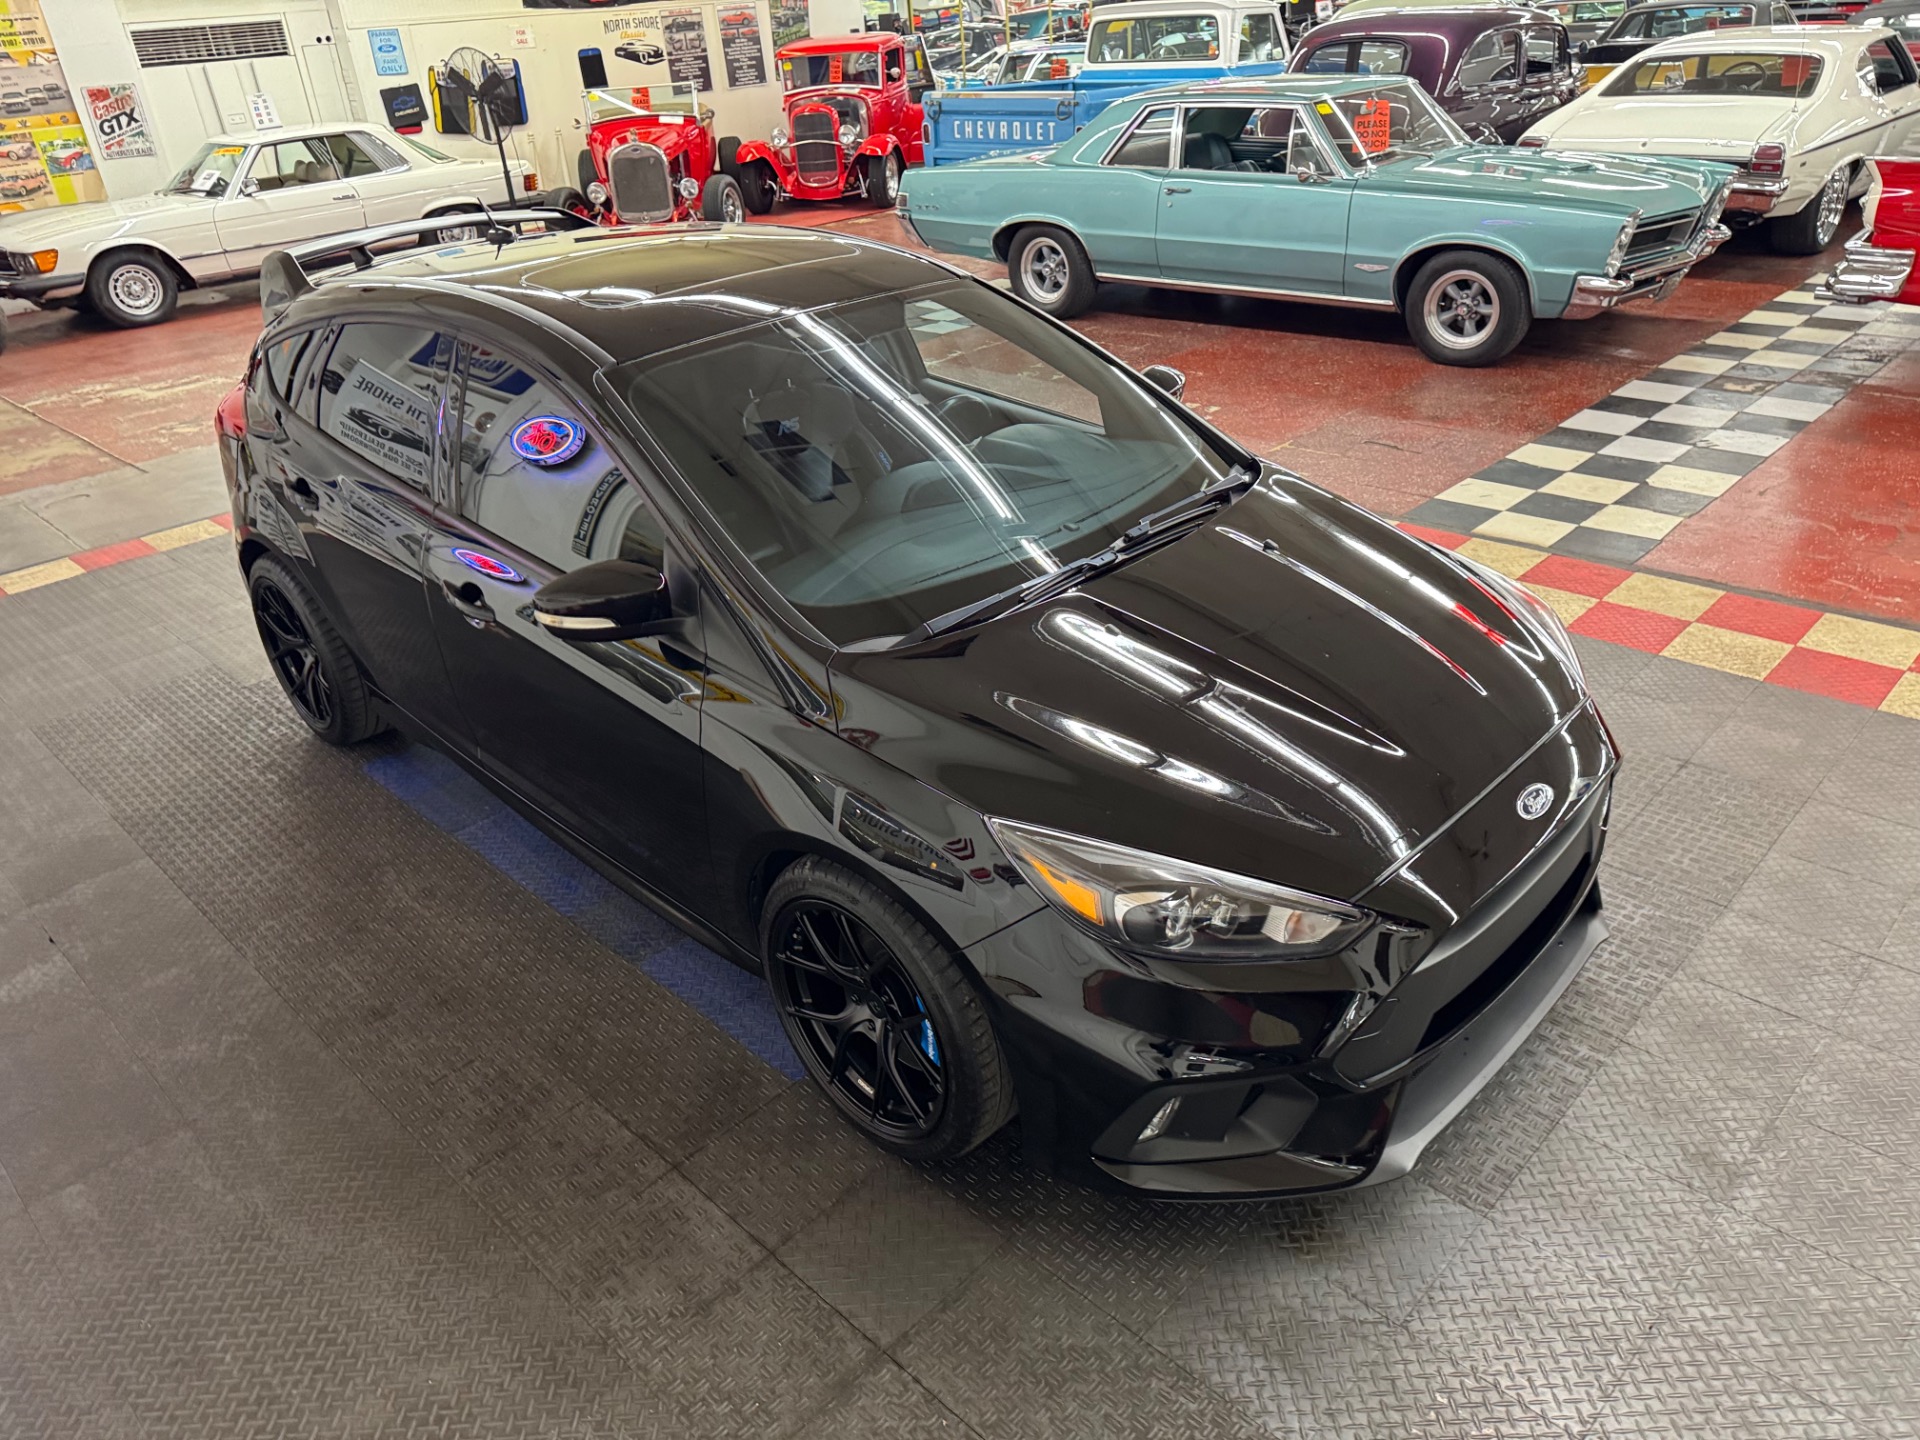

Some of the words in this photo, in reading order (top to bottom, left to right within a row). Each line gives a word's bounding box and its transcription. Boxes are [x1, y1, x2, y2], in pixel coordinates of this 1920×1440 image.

[603, 18, 631, 34] NORTH
[633, 16, 660, 30] SHORE
[381, 65, 403, 73] ONLY
[92, 93, 137, 121] Castro
[99, 106, 141, 136] GTX
[1357, 120, 1387, 129] PLEASE
[953, 120, 1056, 141] CHEVROLET
[1357, 130, 1370, 138] DO
[1371, 130, 1387, 138] NOT
[1361, 140, 1387, 148] OUCH
